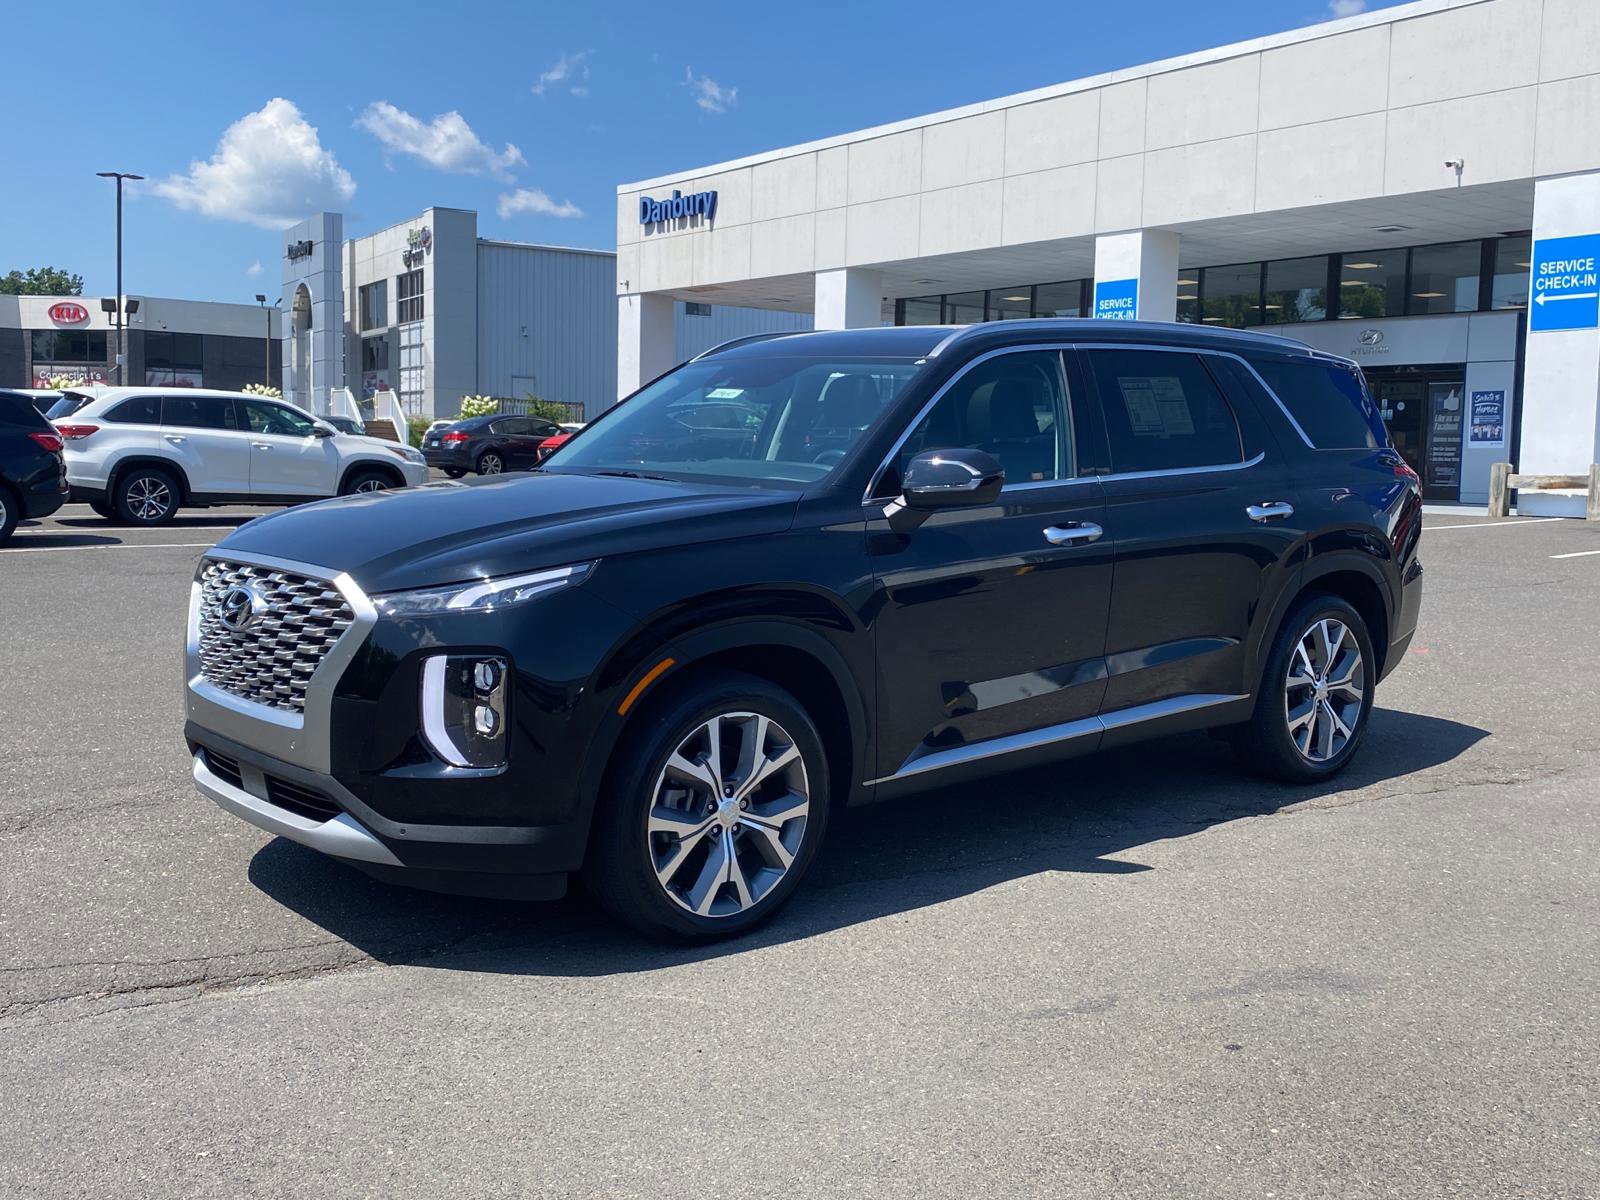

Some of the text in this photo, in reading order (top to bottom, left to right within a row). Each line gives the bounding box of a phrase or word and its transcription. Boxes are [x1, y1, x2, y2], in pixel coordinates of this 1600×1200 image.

[640, 190, 718, 225] Danbury
[1539, 257, 1595, 275] SERVICE
[1535, 273, 1597, 291] CHECK-IN
[1099, 297, 1133, 310] SERVICE
[55, 307, 81, 320] KIA
[1097, 309, 1134, 320] CHECK-IN
